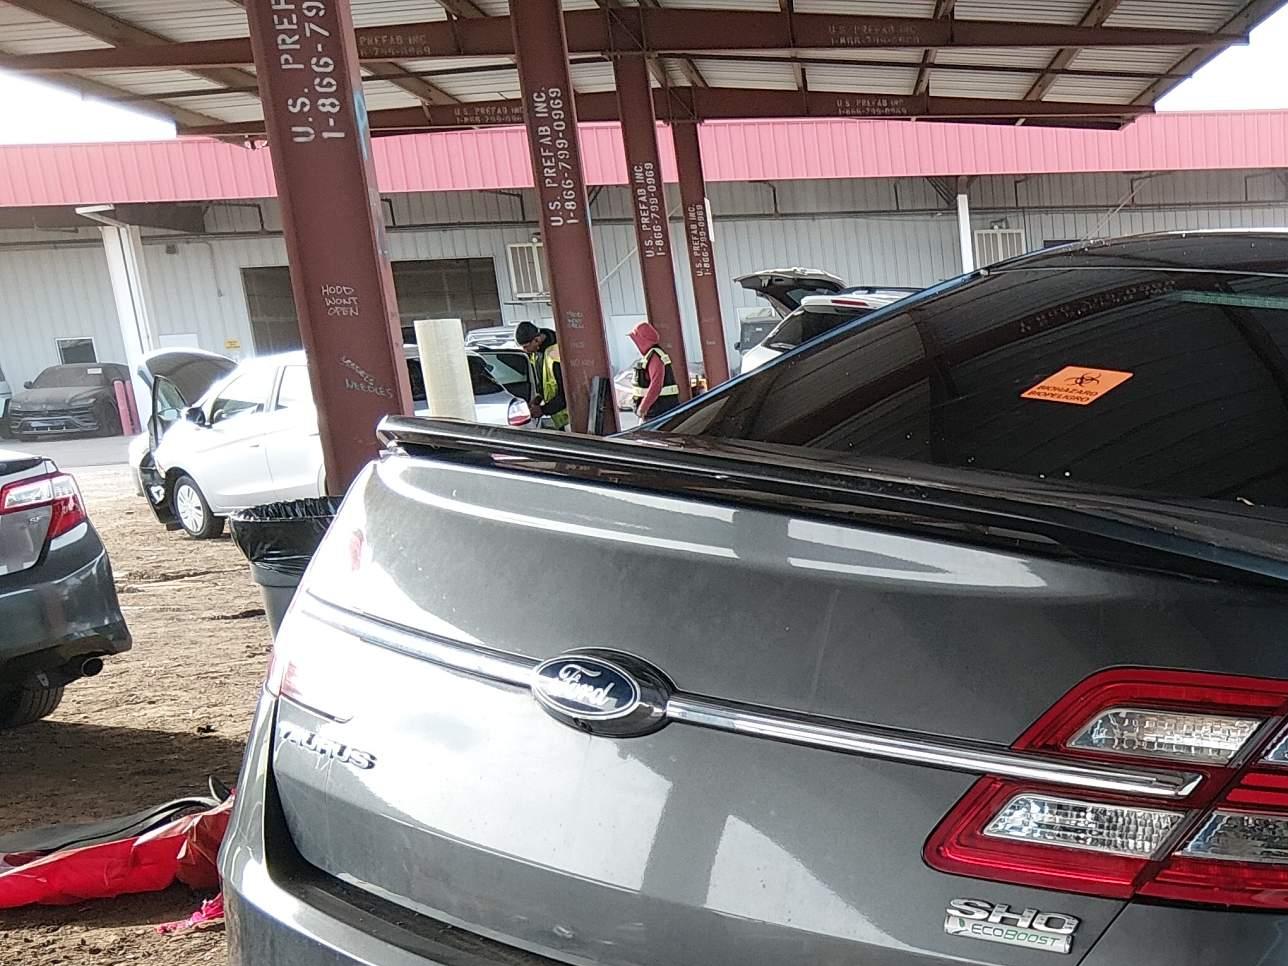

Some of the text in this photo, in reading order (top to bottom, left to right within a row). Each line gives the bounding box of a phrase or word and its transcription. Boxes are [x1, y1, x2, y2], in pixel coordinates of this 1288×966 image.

[302, 1, 345, 138] 1-866-79
[288, 88, 316, 142] U.S.
[533, 87, 564, 226] U.S. PREFAB INC.
[548, 88, 579, 224] 1-866-799-0969
[637, 188, 651, 231] PREFAB
[644, 162, 666, 256] 1-866-799-0969
[644, 236, 655, 257] U.S.
[689, 223, 701, 257] PREFAB
[321, 284, 354, 296] HOOD
[324, 296, 358, 306] WONT
[327, 305, 359, 316] OPEN
[1027, 390, 1090, 402] BIOPELIGRO
[1036, 385, 1099, 396] BIOHAZARD
[559, 664, 616, 706] Ford
[946, 899, 1079, 935] SHO
[971, 923, 1061, 947] ECOBOOST
